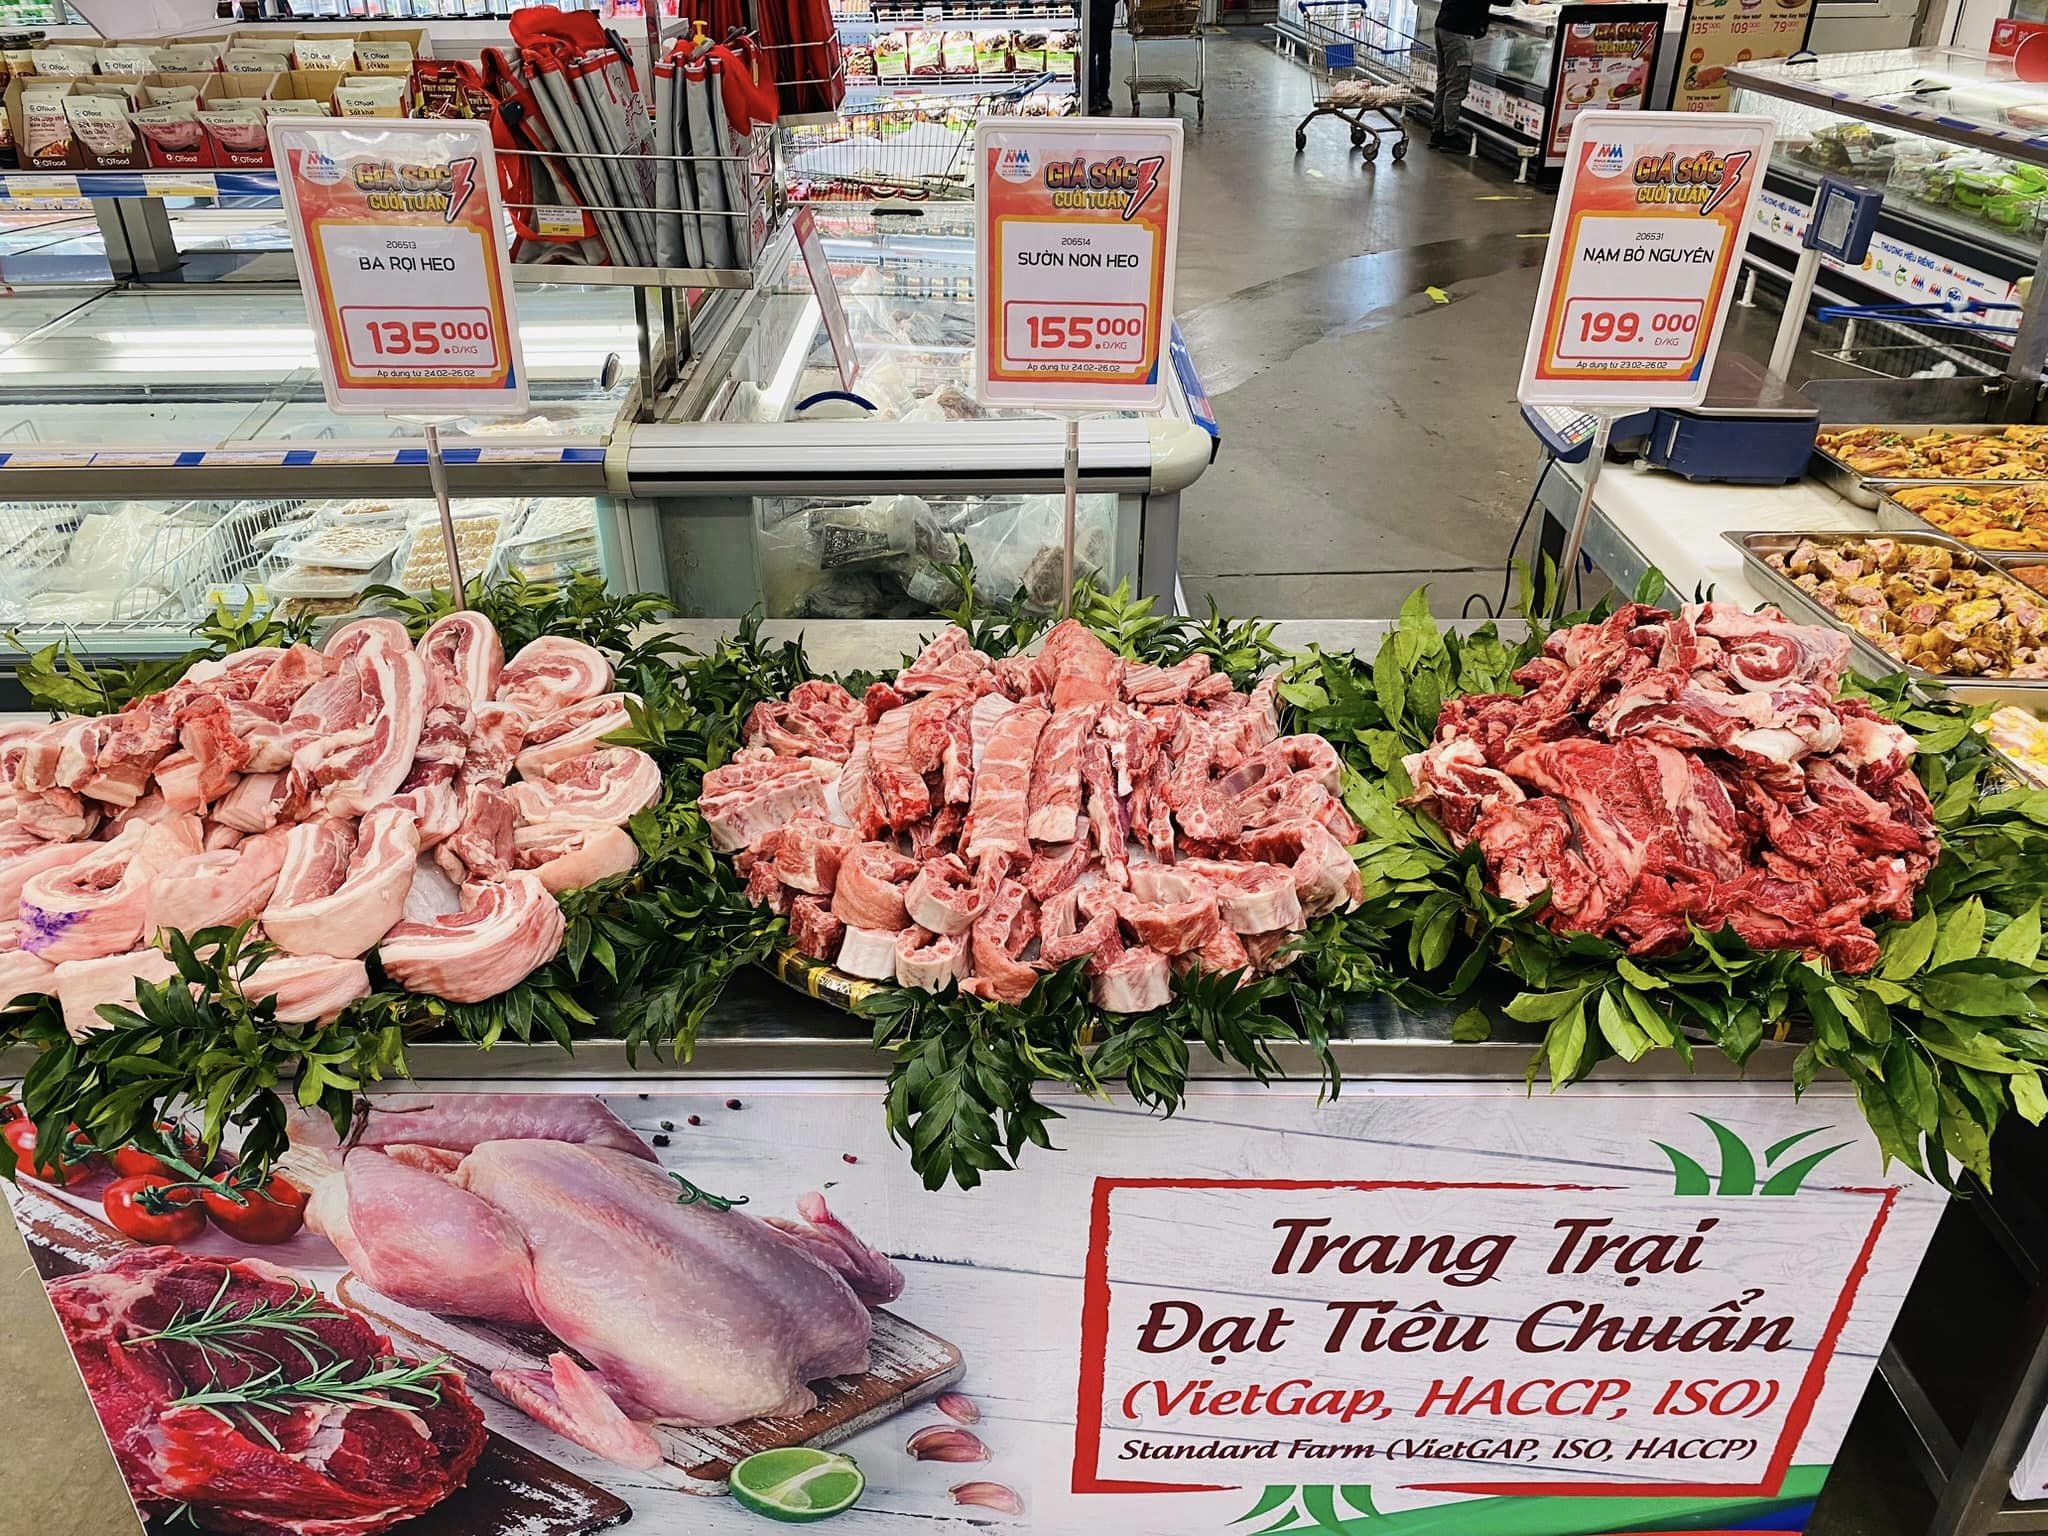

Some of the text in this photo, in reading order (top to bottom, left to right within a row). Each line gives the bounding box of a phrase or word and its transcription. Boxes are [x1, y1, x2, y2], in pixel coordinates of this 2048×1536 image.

[1046, 157, 1137, 190] GIÁ SỐC
[1634, 151, 1724, 185] GIÁ SỐC
[386, 240, 417, 249] 206513
[1061, 238, 1091, 246] 206514
[1635, 232, 1664, 241] 206531
[359, 256, 456, 273] BA RỌI HEO
[1018, 249, 1139, 268] SƯỜN NON HEO
[1583, 247, 1620, 264] NẠM
[1271, 1217, 1719, 1287] Trang Trại
[1137, 1288, 1795, 1365] Đạt Tiêu Chuẩn
[1122, 1376, 1780, 1423] (VietGap, HACCP, ISO)
[1118, 1437, 1758, 1462] Standard Farm (VietGAP, ISO, HACCP)
